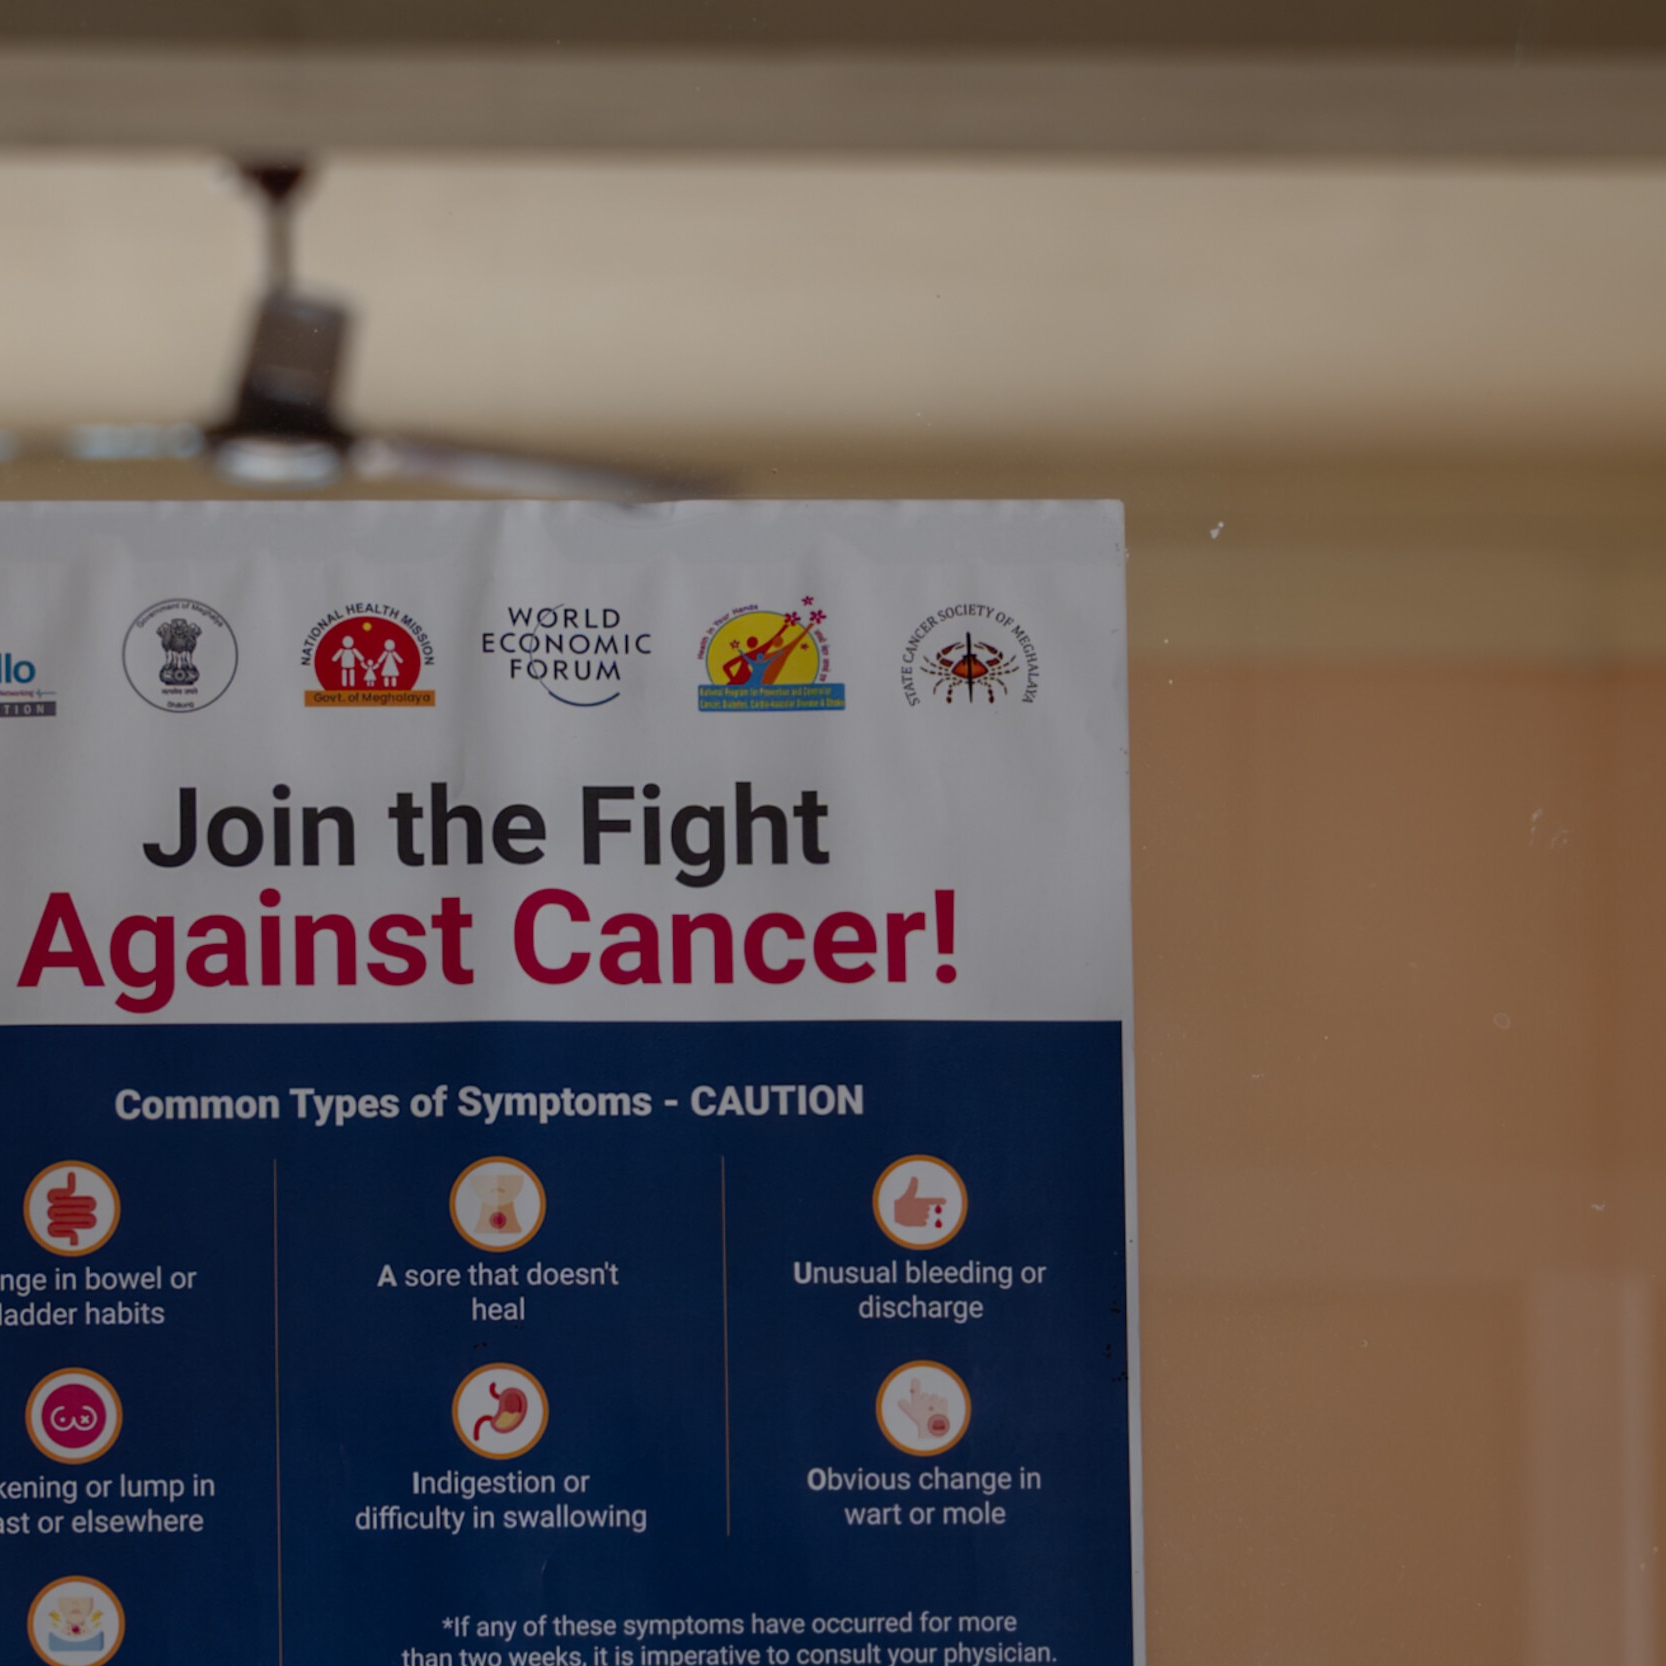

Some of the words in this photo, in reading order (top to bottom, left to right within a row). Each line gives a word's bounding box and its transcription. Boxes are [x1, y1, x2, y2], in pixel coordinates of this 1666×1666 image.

[508, 606, 621, 629] WORLD
[937, 603, 996, 623] SOCIETY
[995, 611, 1015, 628] OF
[301, 610, 344, 666] NATIONAL
[345, 602, 400, 619] HEALTH
[400, 614, 435, 666] MISSION
[482, 632, 652, 655] ECONOMIC
[902, 615, 938, 664] CANCER
[510, 658, 621, 680] FORUM
[1011, 625, 1040, 704] MEGHALAYA
[314, 692, 345, 702] Govt.
[348, 692, 359, 702] of
[362, 692, 431, 705] Meghalaya
[901, 666, 921, 707] STATE
[143, 784, 355, 868] Join
[388, 782, 546, 867] the
[582, 782, 829, 888] Fight
[17, 888, 474, 1014] Against
[514, 888, 956, 985] Cancer!
[115, 1089, 279, 1120] Common
[289, 1088, 399, 1126] Types
[410, 1085, 448, 1117] of
[458, 1086, 652, 1124] Symptoms
[691, 1085, 863, 1116] CAUTION
[55, 1268, 76, 1290] in
[86, 1266, 161, 1290] bowel
[170, 1271, 197, 1289] or
[377, 1264, 397, 1287] A
[405, 1269, 461, 1287] sore
[467, 1262, 519, 1286] that
[527, 1261, 619, 1285] doesn't
[794, 1260, 897, 1284] Unusual
[906, 1260, 1012, 1289] bleeding
[1021, 1266, 1047, 1284] or
[86, 1301, 165, 1325] habits
[472, 1297, 524, 1320] heal
[859, 1295, 983, 1324] discharge
[86, 1480, 112, 1498] or
[121, 1474, 184, 1502] lump
[193, 1474, 215, 1496] in
[413, 1470, 555, 1499] Indigestion
[564, 1475, 590, 1493] or
[807, 1467, 912, 1491] Obvious
[917, 1466, 1012, 1495] change
[1020, 1467, 1041, 1489] in
[37, 1516, 64, 1533] or
[71, 1508, 203, 1533] elsewhere
[355, 1505, 465, 1535] difficulty
[473, 1506, 494, 1528] in
[504, 1504, 646, 1533] swallowing
[844, 1504, 902, 1525] wart
[909, 1507, 935, 1525] or
[943, 1500, 1006, 1524] mole
[477, 1621, 517, 1642] any
[523, 1614, 547, 1637] of
[552, 1615, 616, 1636] these
[624, 1616, 744, 1641] symptoms
[752, 1613, 805, 1634] have
[812, 1611, 912, 1634] occurred
[919, 1611, 952, 1632] for
[959, 1616, 1017, 1632] more
[594, 1646, 608, 1666] it
[615, 1646, 634, 1666] is
[766, 1646, 790, 1665] to
[796, 1643, 881, 1665] consult
